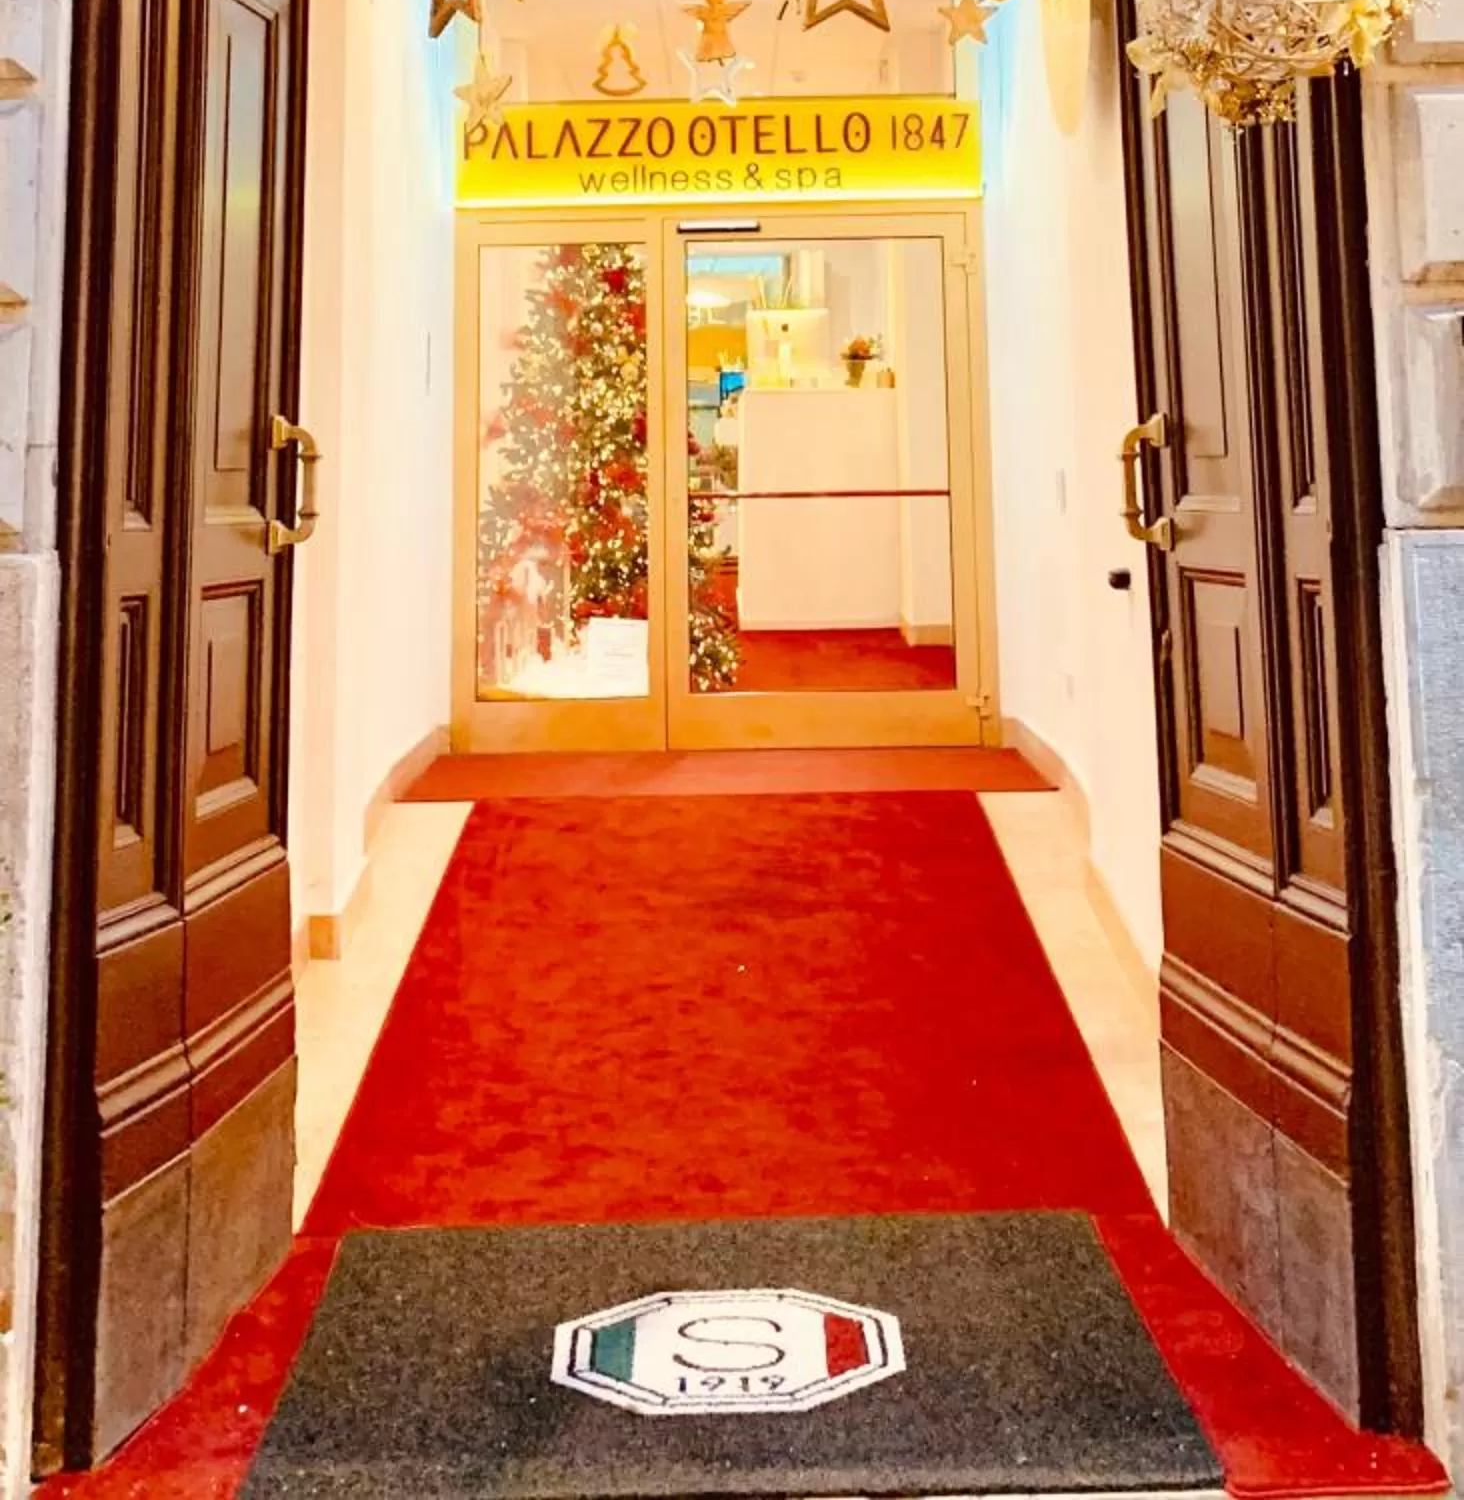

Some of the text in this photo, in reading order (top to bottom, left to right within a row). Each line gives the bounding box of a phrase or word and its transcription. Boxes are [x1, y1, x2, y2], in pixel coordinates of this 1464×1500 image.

[463, 111, 970, 160] PALAZZO OTELLO 1847
[579, 160, 844, 194] wellness & spa
[673, 1315, 786, 1373] S
[675, 1374, 787, 1396] 1919
